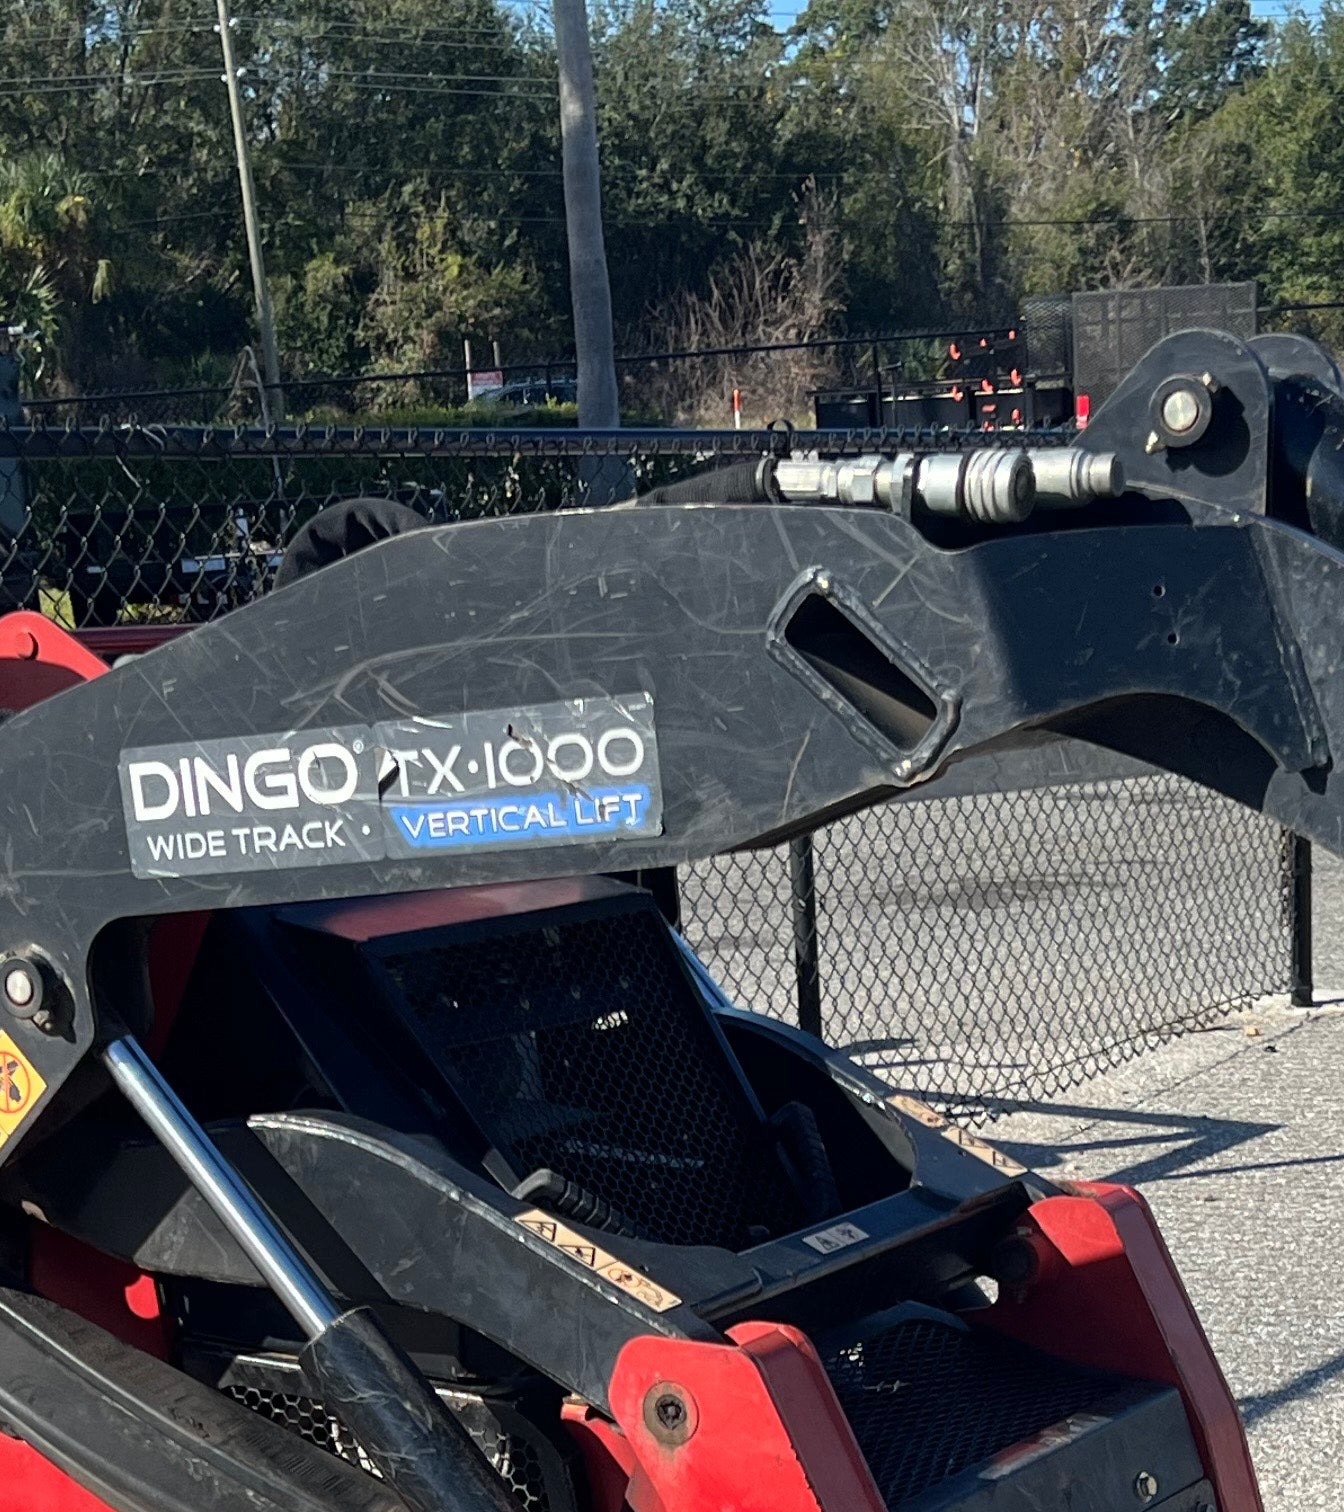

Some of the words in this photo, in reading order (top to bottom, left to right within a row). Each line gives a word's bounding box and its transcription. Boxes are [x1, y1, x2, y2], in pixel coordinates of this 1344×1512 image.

[128, 743, 357, 822] DINGO
[401, 798, 567, 840] VERTICAL
[577, 793, 644, 827] LIFT
[146, 830, 227, 861] WIDE
[237, 820, 346, 855] TRACK
